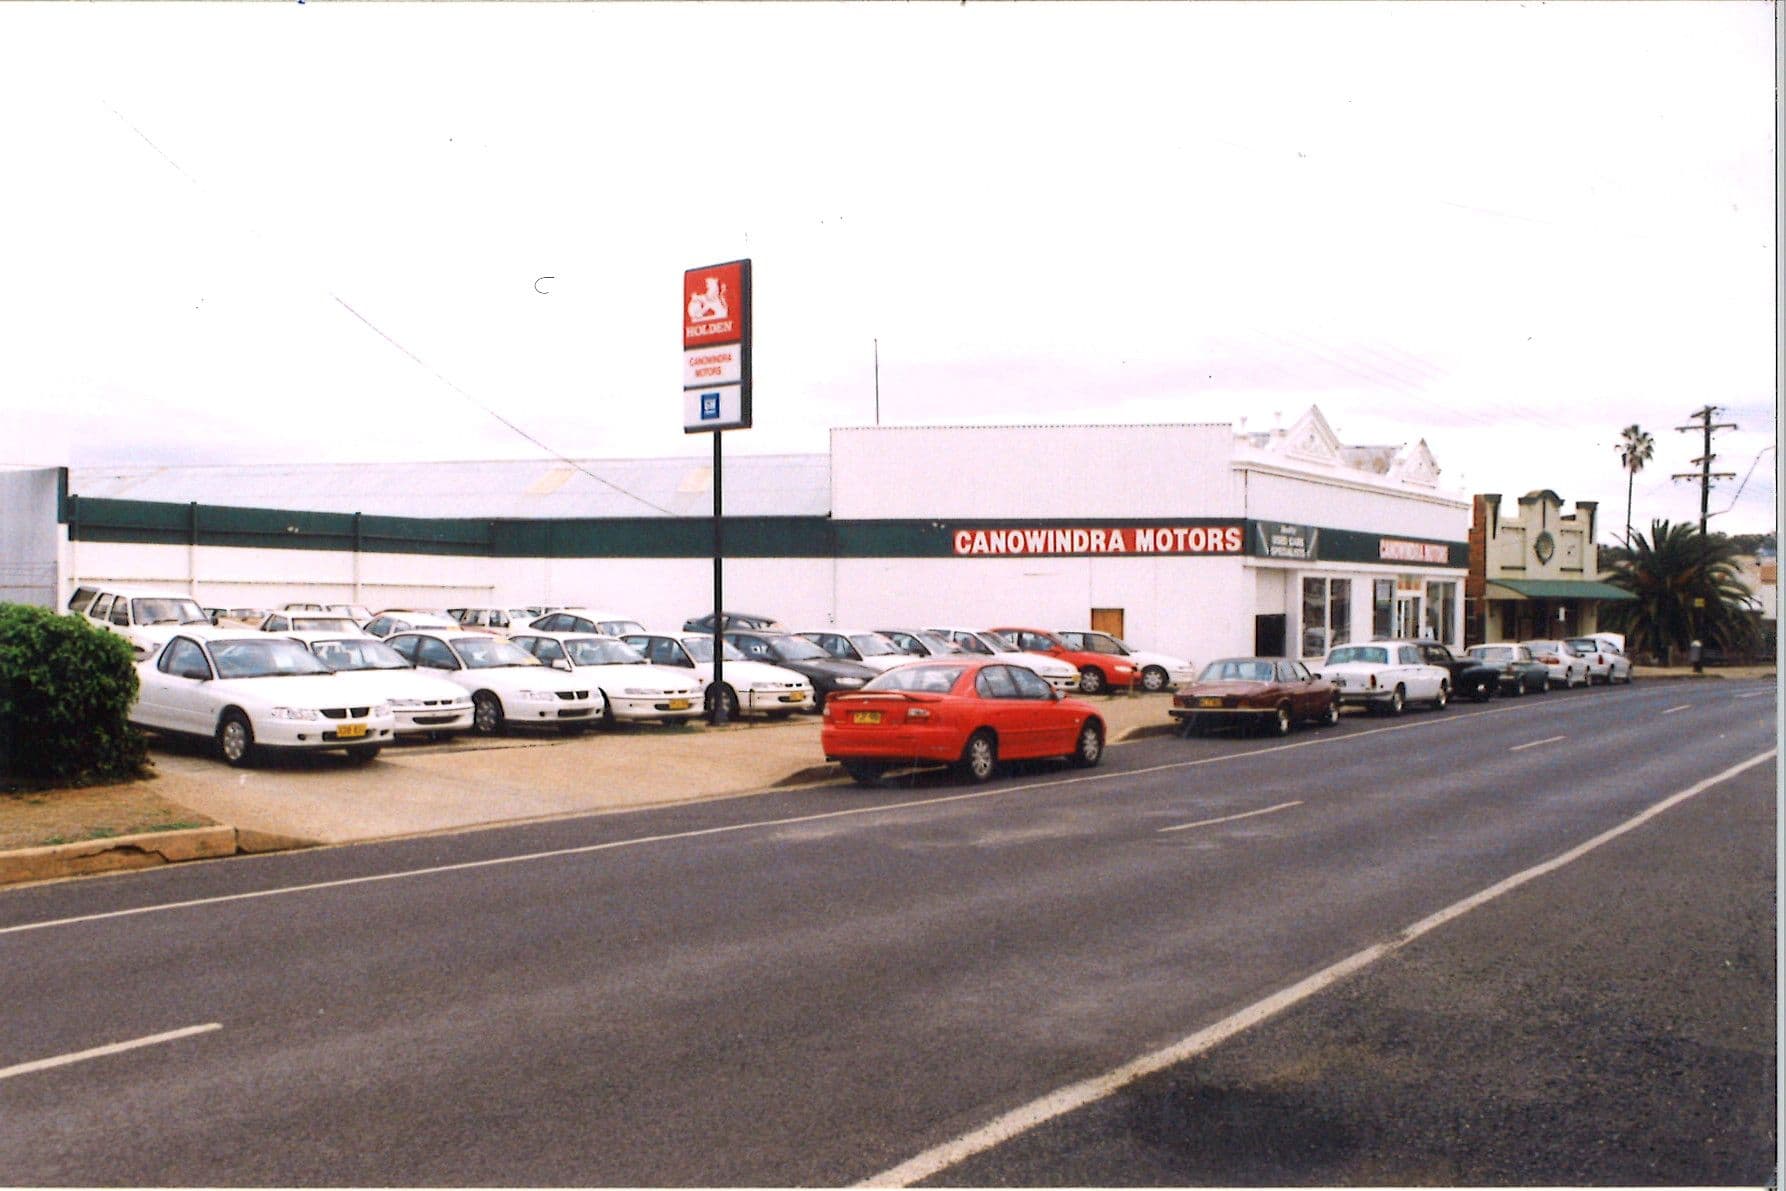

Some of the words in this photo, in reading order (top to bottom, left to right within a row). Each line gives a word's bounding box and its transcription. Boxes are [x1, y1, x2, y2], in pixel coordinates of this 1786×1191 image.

[686, 320, 732, 337] HOLDEN
[695, 366, 721, 377] MOTORS
[955, 529, 1125, 554] CANOWINDRA
[1135, 527, 1242, 552] MOTORS
